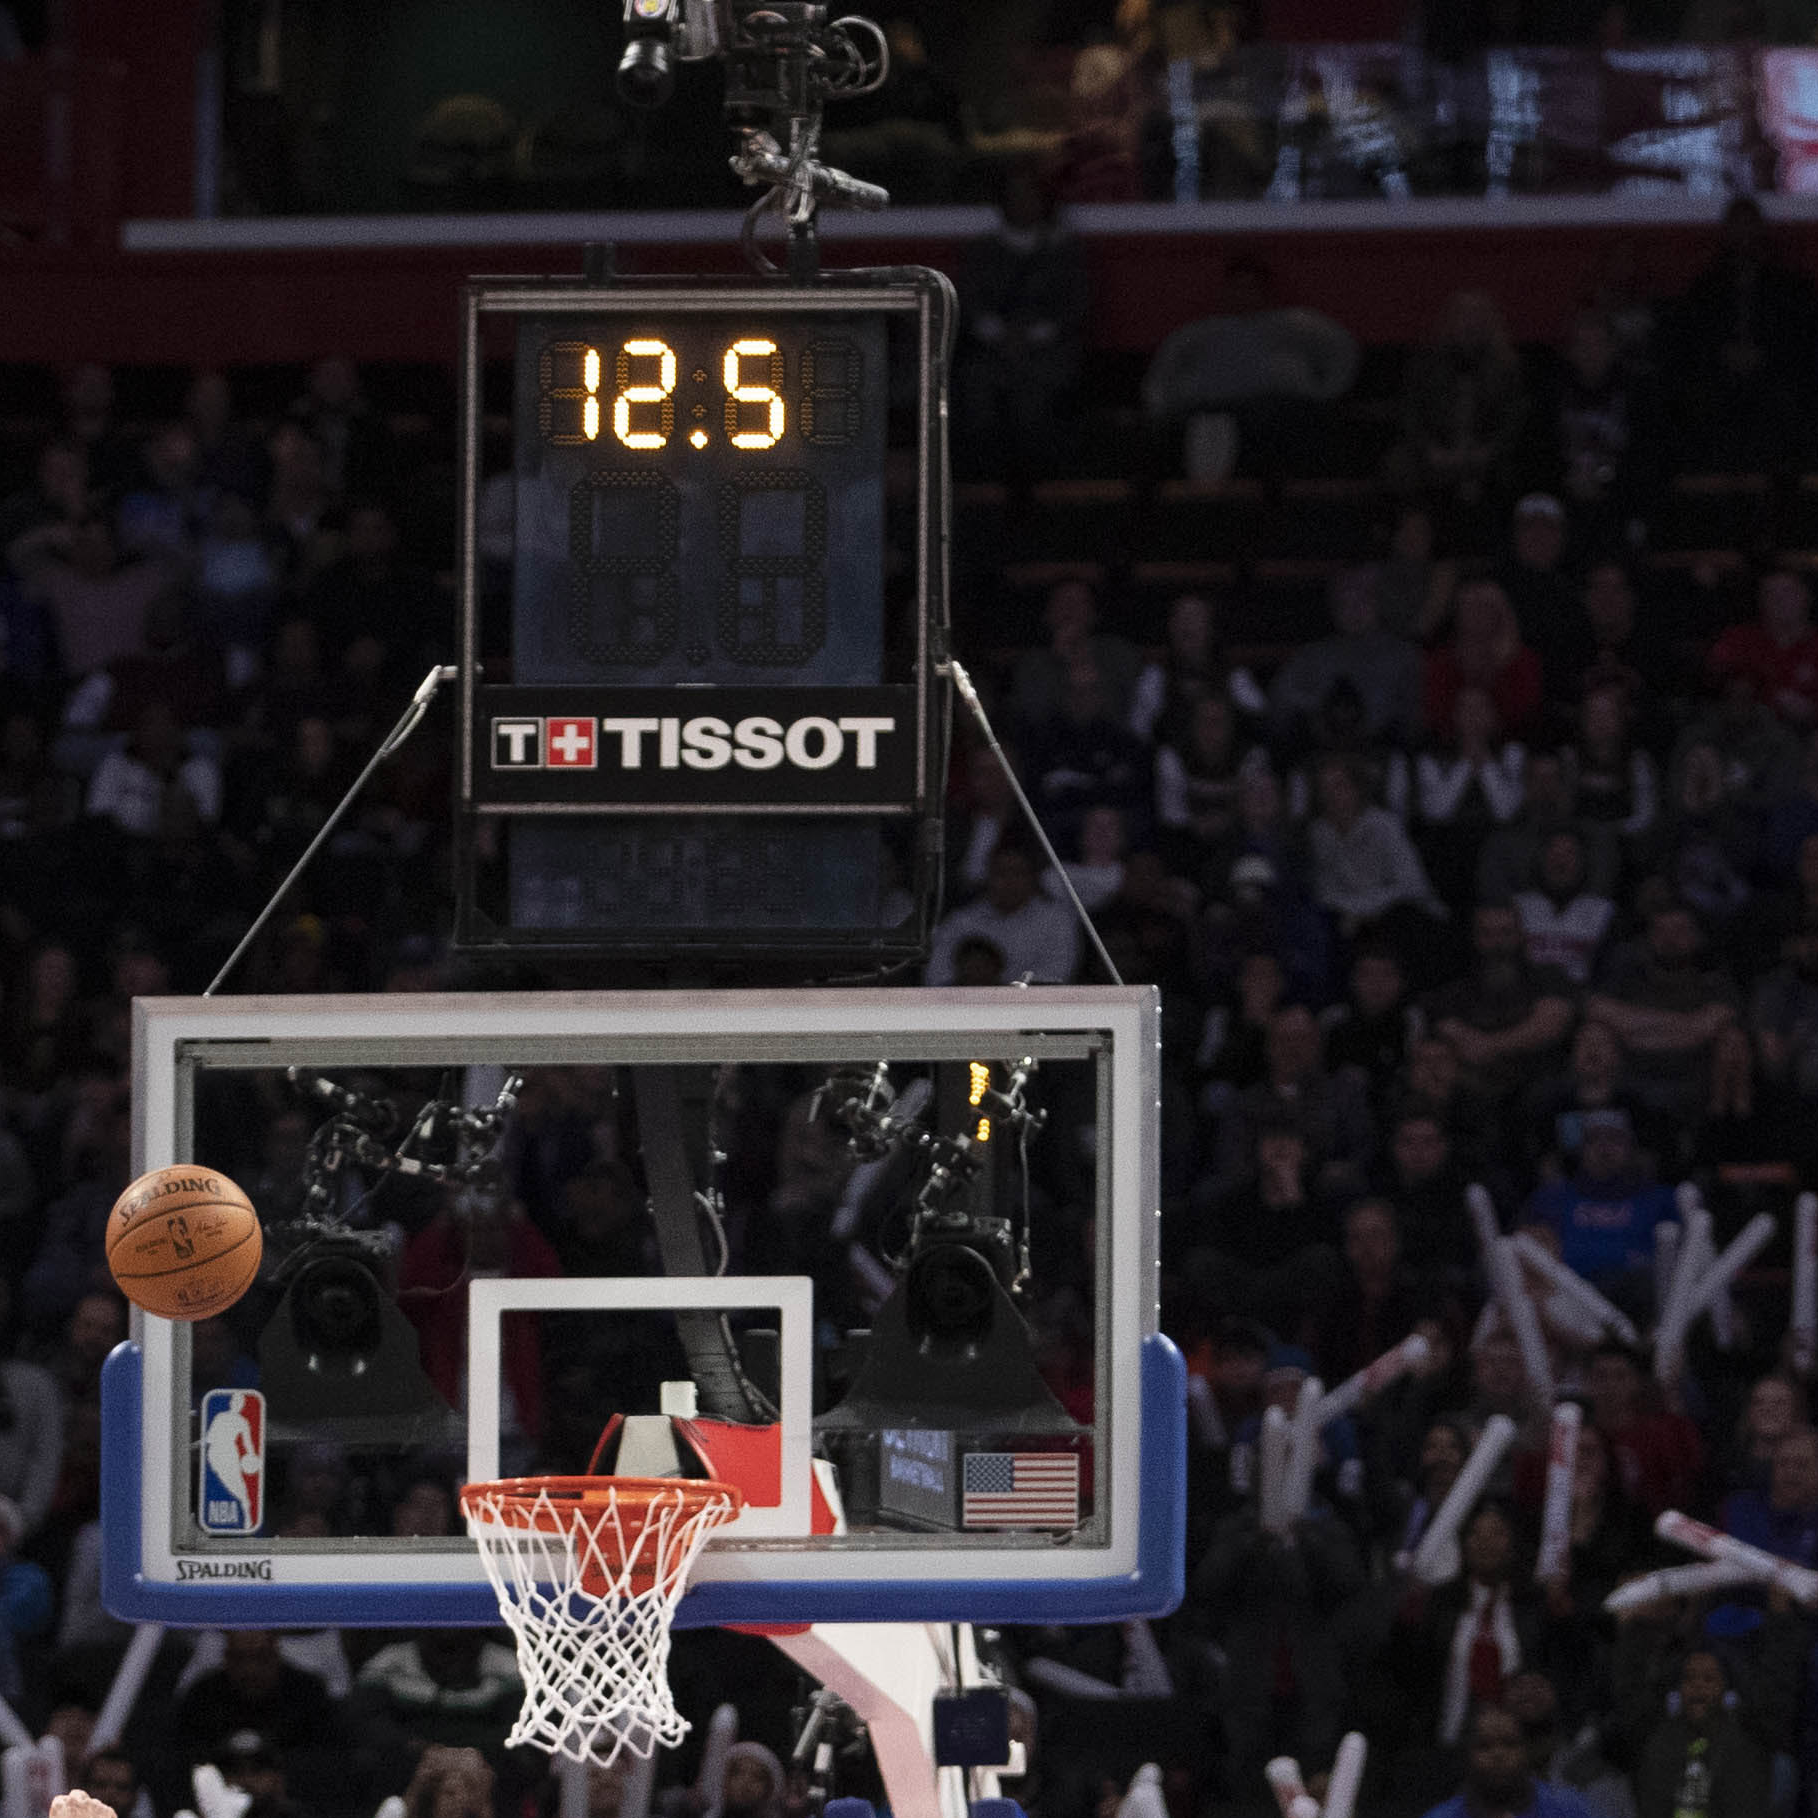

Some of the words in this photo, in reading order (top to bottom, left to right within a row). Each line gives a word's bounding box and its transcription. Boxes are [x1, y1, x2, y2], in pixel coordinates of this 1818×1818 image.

[581, 338, 786, 450] 12.5
[603, 716, 897, 771] TISSOT
[175, 1559, 273, 1582] SPALDING
